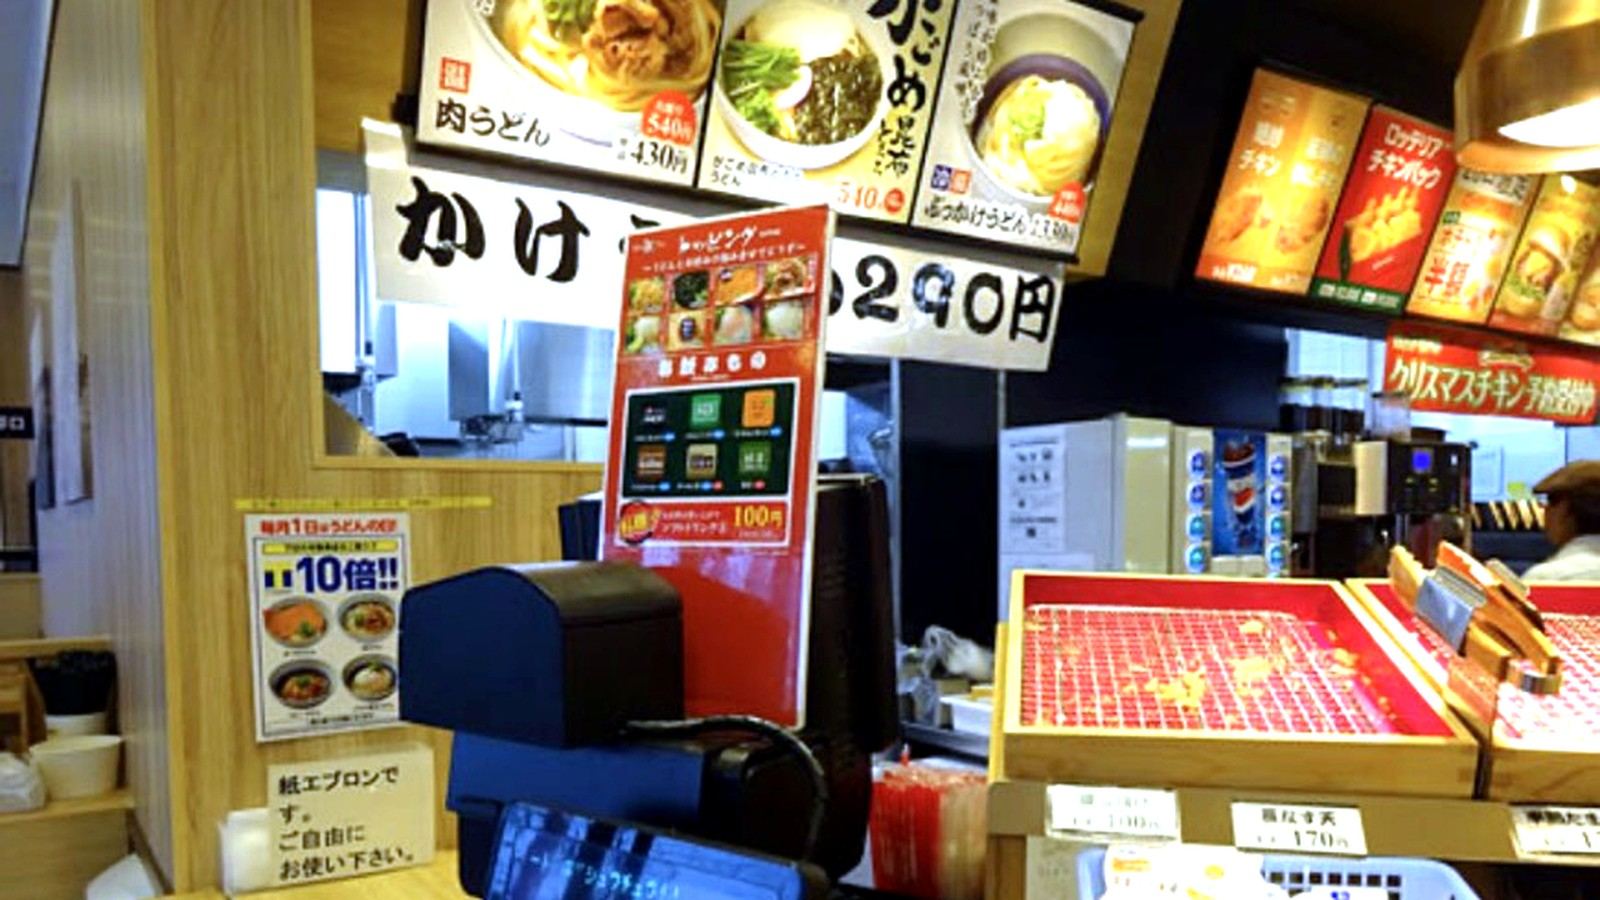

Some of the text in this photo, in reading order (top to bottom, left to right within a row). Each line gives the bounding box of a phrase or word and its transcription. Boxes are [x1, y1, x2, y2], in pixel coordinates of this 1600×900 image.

[435, 97, 551, 147] 肉うどん
[630, 140, 688, 175] 430円
[395, 175, 660, 284] かけ
[923, 195, 1028, 236] ぶっかけうどん
[734, 504, 783, 529] 100円
[296, 555, 399, 594] 10倍!!
[279, 804, 312, 824] す。
[278, 824, 366, 851] ご自由に
[279, 847, 414, 881] お使い下さい。
